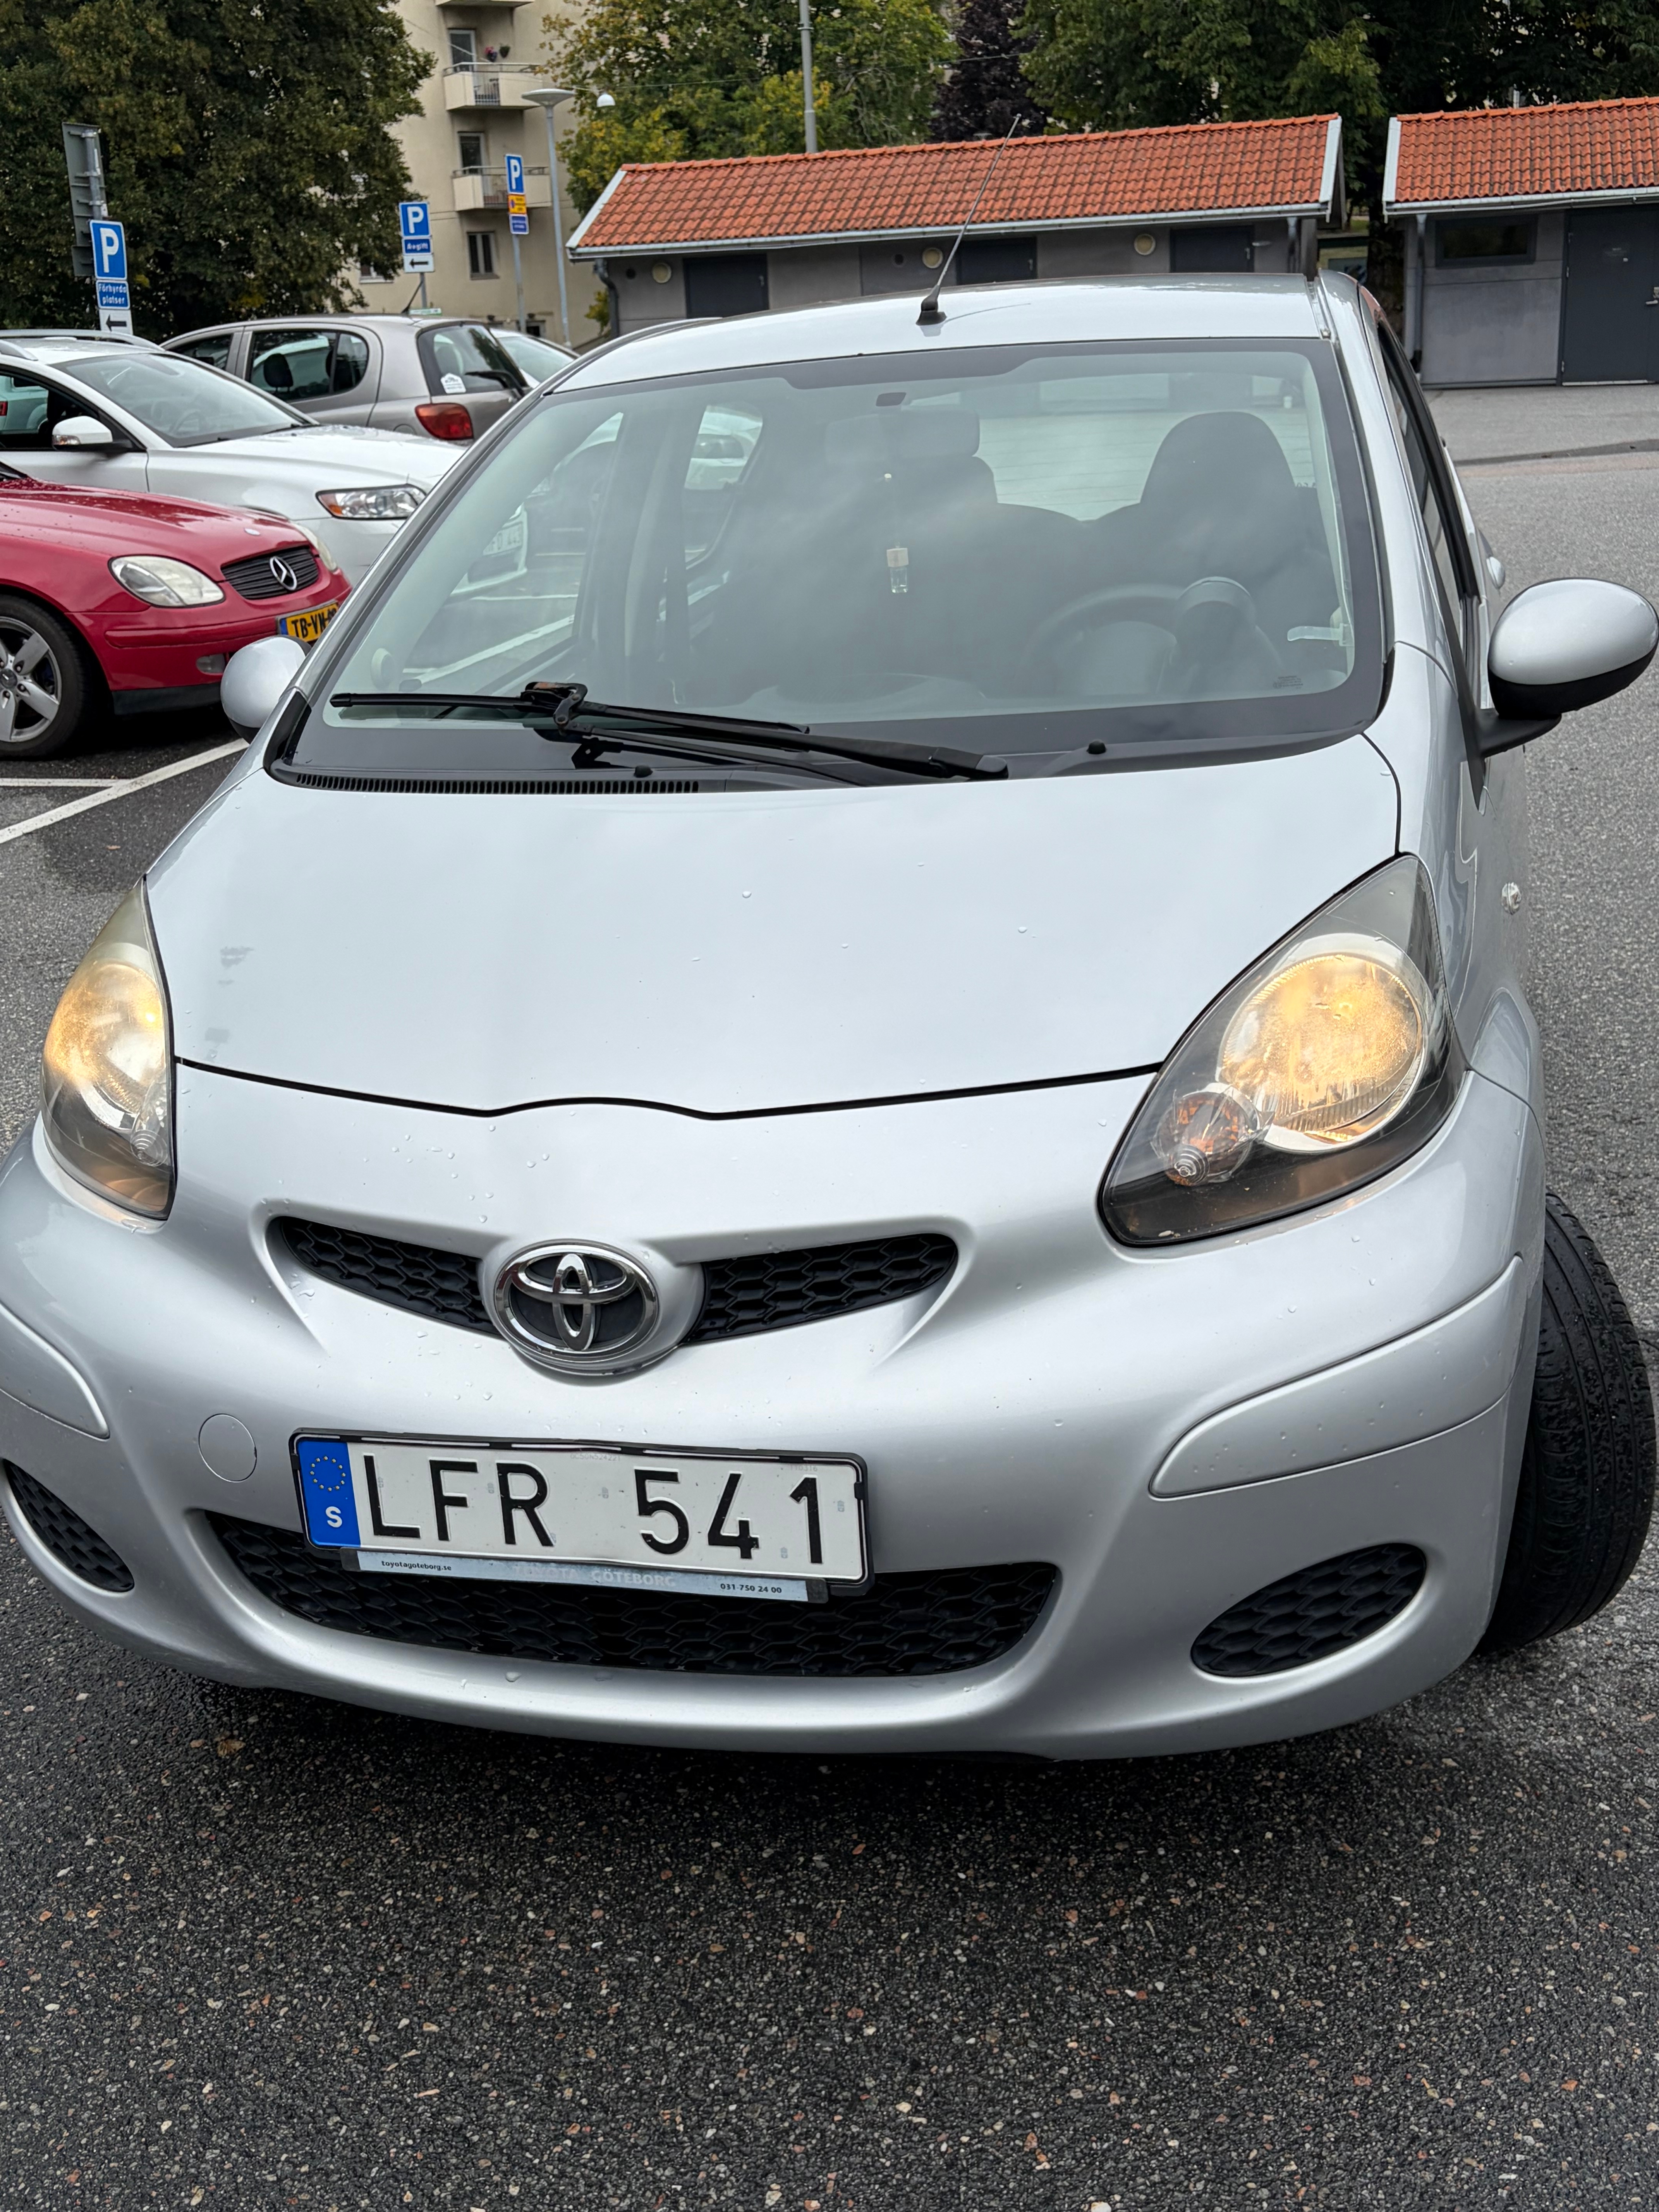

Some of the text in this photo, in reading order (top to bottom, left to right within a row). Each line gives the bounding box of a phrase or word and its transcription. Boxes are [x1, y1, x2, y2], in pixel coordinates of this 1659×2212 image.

[510, 159, 520, 189] P
[407, 206, 424, 234] P
[100, 227, 119, 273] P
[102, 295, 125, 305] platser
[325, 1506, 343, 1528] S
[363, 1454, 823, 1564] LFR 541
[381, 1560, 452, 1571] toyotagoteborg.se
[591, 1568, 676, 1587] GÖTEBORG
